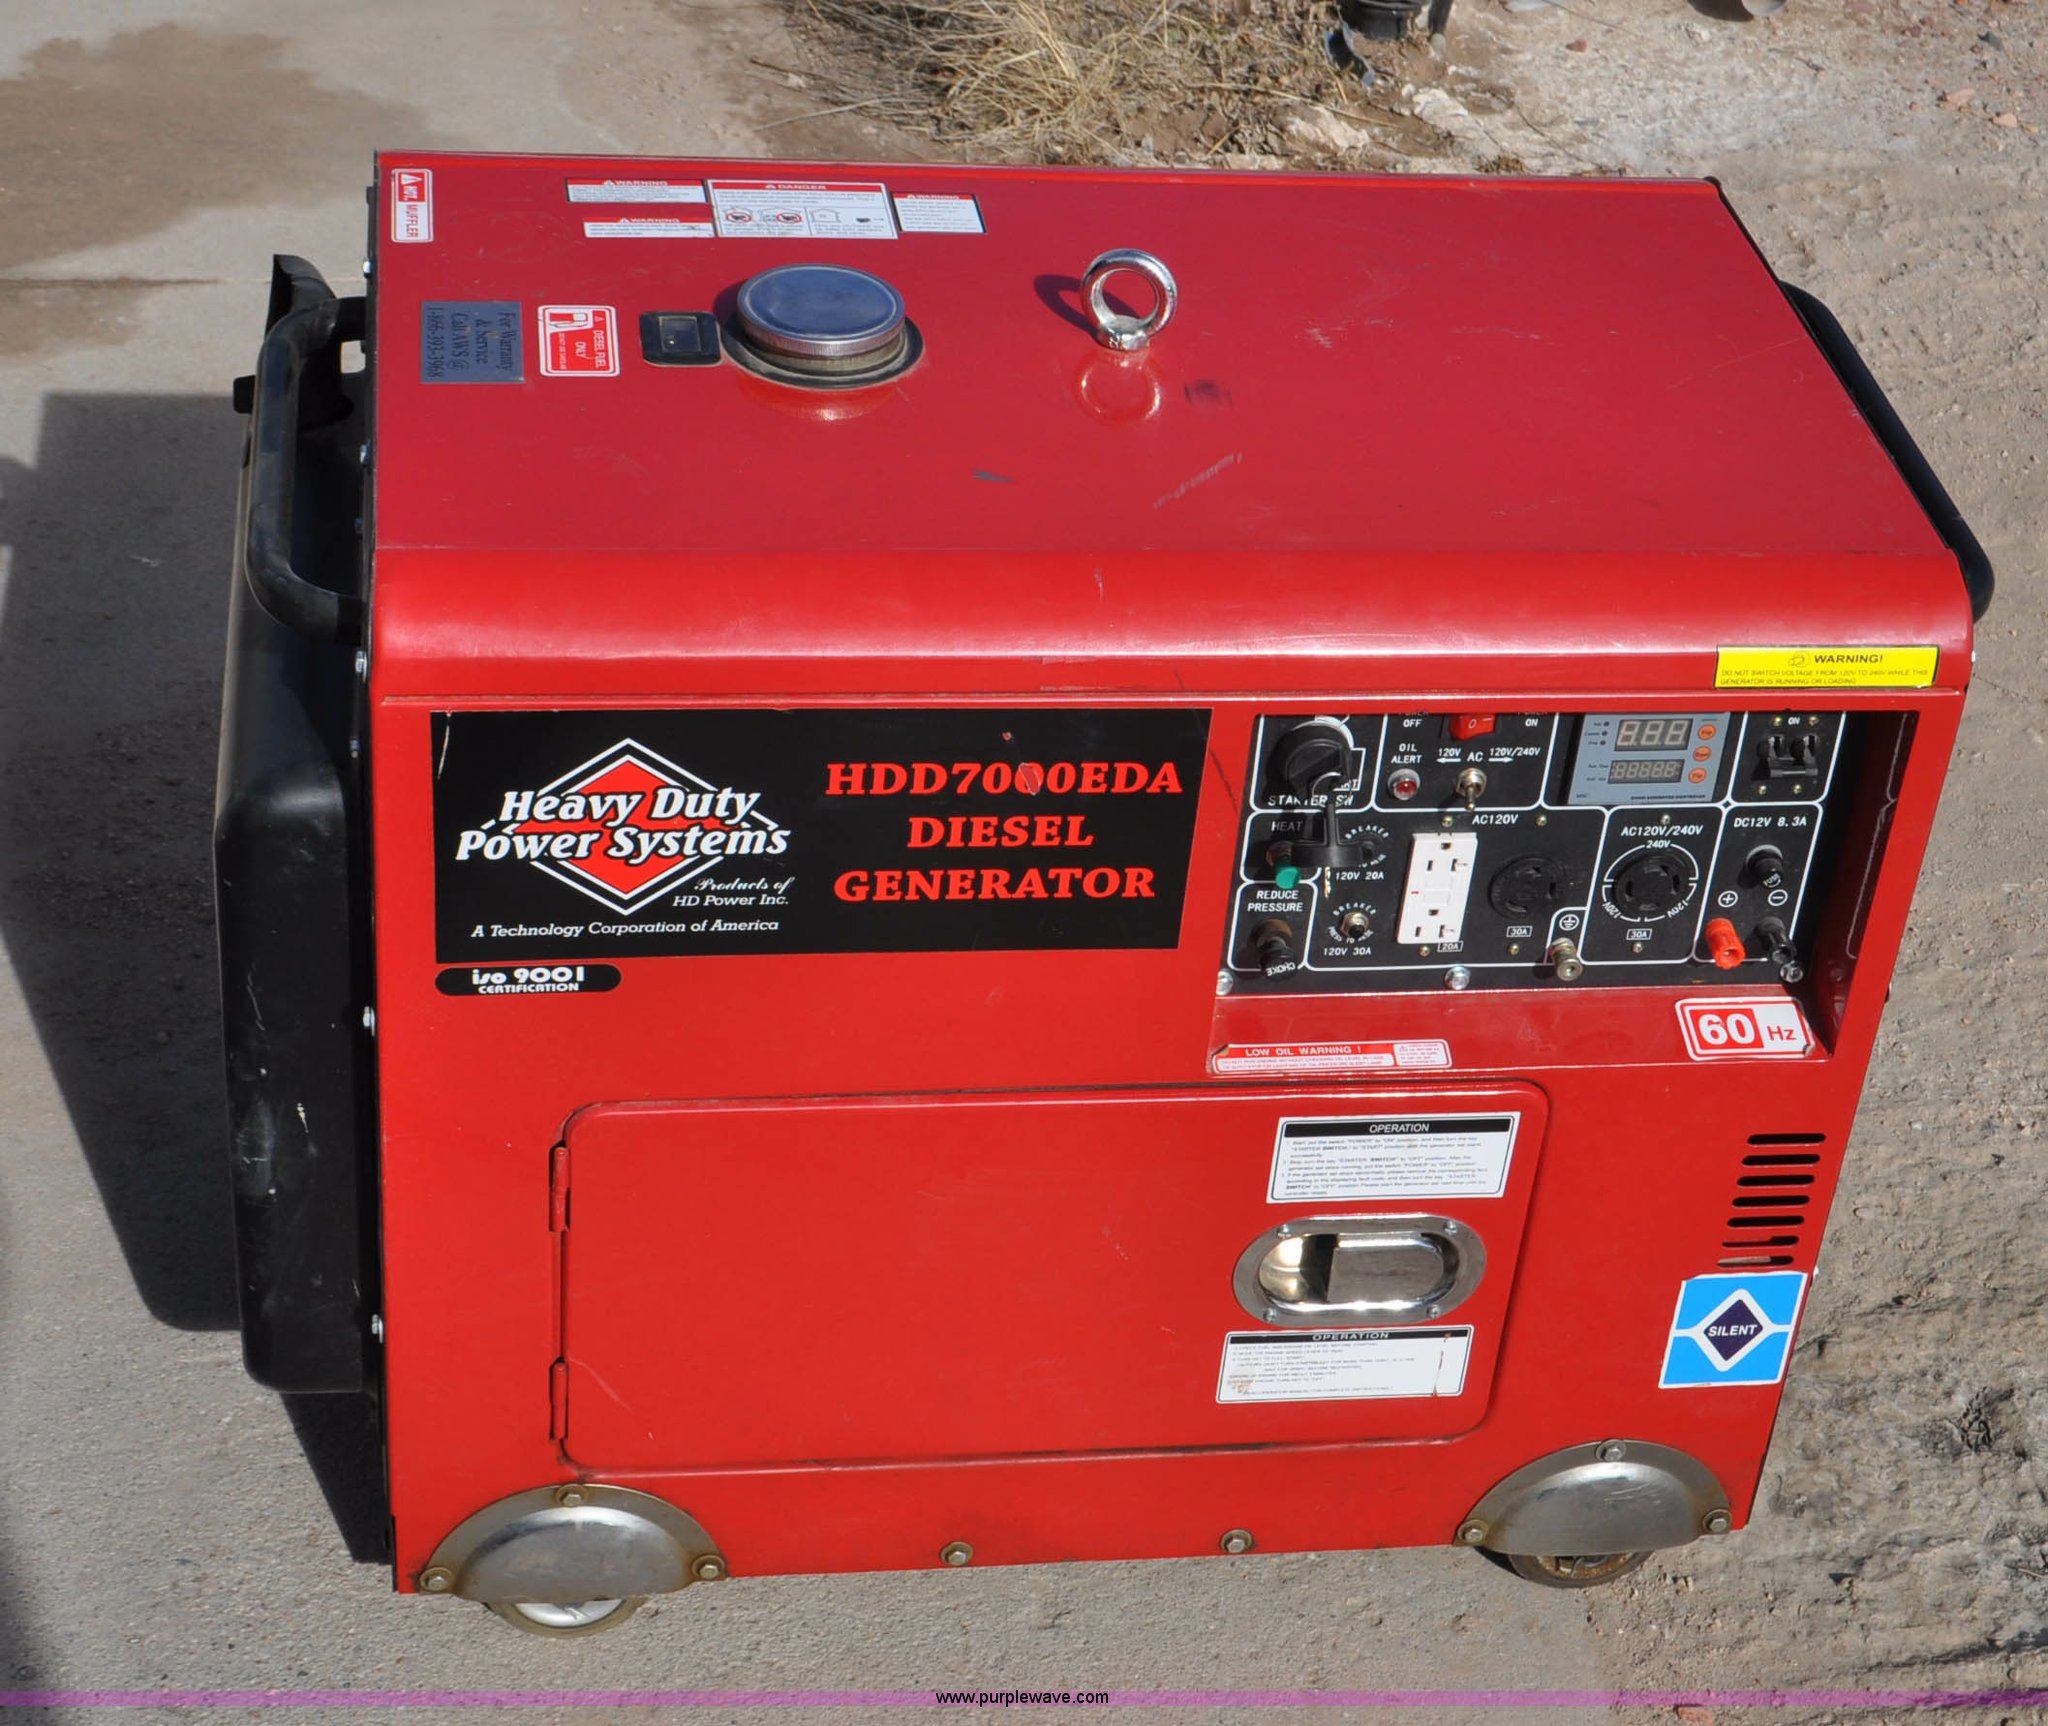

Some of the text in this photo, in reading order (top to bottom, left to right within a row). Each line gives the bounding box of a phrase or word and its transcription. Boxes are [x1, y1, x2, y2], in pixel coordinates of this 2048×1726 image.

[451, 313, 468, 331] Call
[451, 333, 469, 357] AWS
[475, 331, 493, 364] Service
[496, 311, 517, 372] For Warranty
[575, 341, 587, 358] ONLY
[1814, 654, 1883, 663] WARNING!
[1403, 719, 1422, 728] OFF
[1525, 719, 1538, 727] ON
[1788, 717, 1801, 725] ON
[1399, 743, 1418, 752] OIL
[1391, 754, 1422, 764] ALERT
[1438, 747, 1541, 762] 120V AC 120V/240V
[825, 761, 1184, 796] HDD7000EDA
[499, 786, 762, 827] Heavy Duty
[1472, 814, 1518, 825] AC120V
[1733, 817, 1772, 828] DC12V
[907, 815, 1095, 848] DIESEL
[1271, 821, 1303, 831] HEAT
[1621, 825, 1703, 836] AC120V/240V
[455, 825, 791, 866] Power Systems
[1646, 840, 1671, 848] 240V
[1336, 871, 1384, 880] 120V 20A
[694, 876, 796, 895] Products of
[833, 867, 1155, 902] GENERATOR
[672, 894, 790, 907] HD Power Inc.
[1256, 890, 1299, 899] REDUCE
[1247, 902, 1303, 912] PRESSURE
[1602, 901, 1621, 919] 120V
[1667, 900, 1689, 918] 120V
[471, 919, 779, 939] A Technology Corporation of America
[1510, 928, 1528, 936] 30A
[1323, 947, 1372, 956] 120V 30A
[1442, 943, 1459, 951] 20A
[513, 966, 585, 984] 9001
[1265, 961, 1296, 977] CHOKE
[478, 983, 579, 995] CERTIFICATION
[1699, 1013, 1797, 1045] 60 Hz
[1245, 1048, 1270, 1057] LOW
[1275, 1047, 1294, 1056] OIL
[1299, 1045, 1352, 1055] WARNING
[1369, 1123, 1430, 1134] OPERATION
[1312, 1332, 1390, 1341] OPERATION
[1708, 1324, 1758, 1337] SILENT
